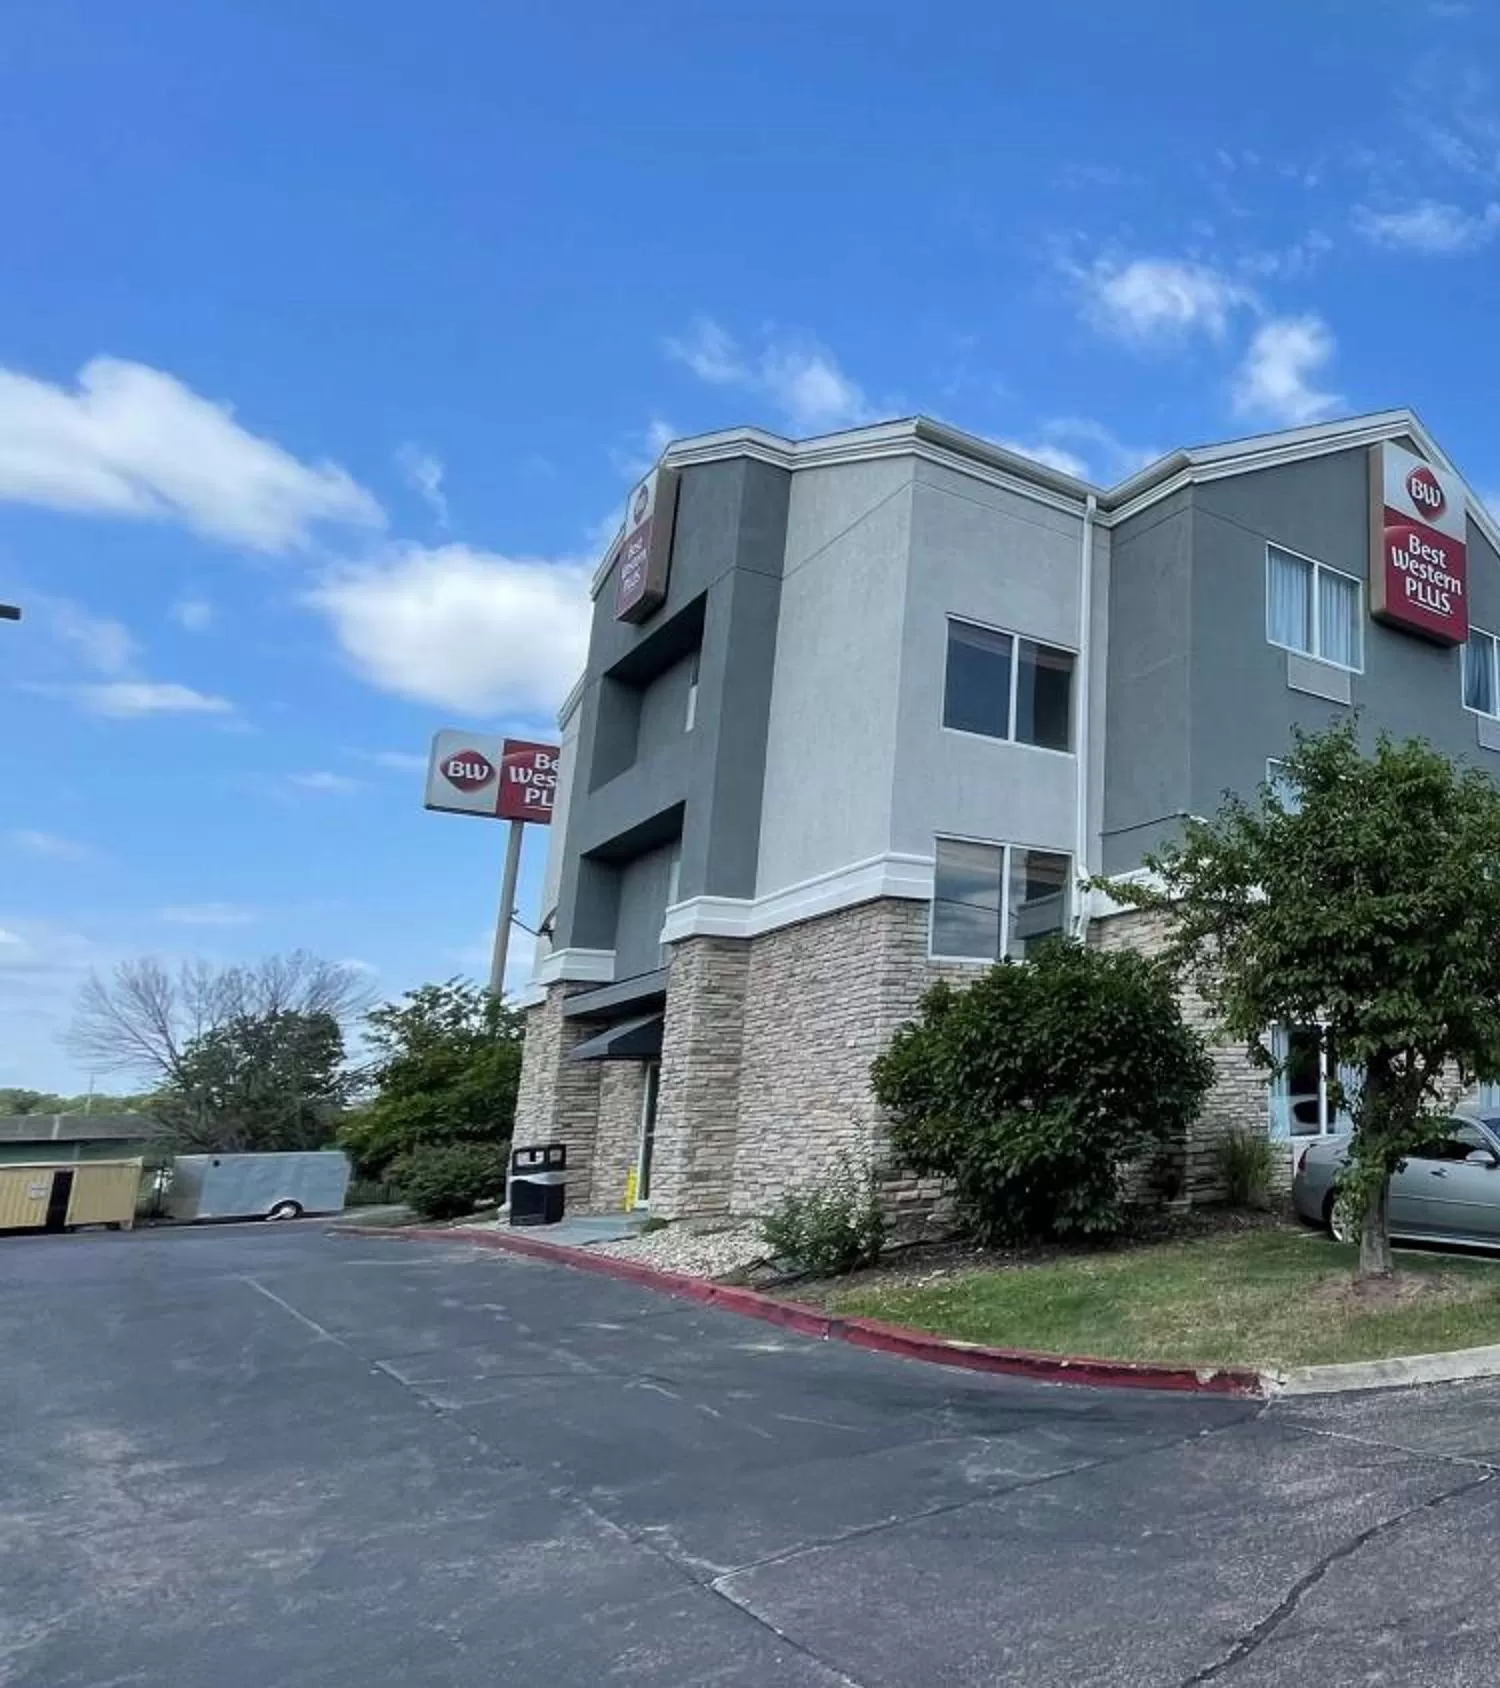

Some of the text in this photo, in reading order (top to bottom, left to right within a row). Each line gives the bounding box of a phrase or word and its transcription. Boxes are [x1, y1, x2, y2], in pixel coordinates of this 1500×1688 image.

[1411, 478, 1441, 507] BW
[1408, 533, 1446, 568] Best
[1391, 546, 1463, 595] Western
[1405, 576, 1451, 613] PLUS
[448, 761, 489, 780] BW
[535, 753, 559, 770] Be
[524, 787, 553, 806] PL
